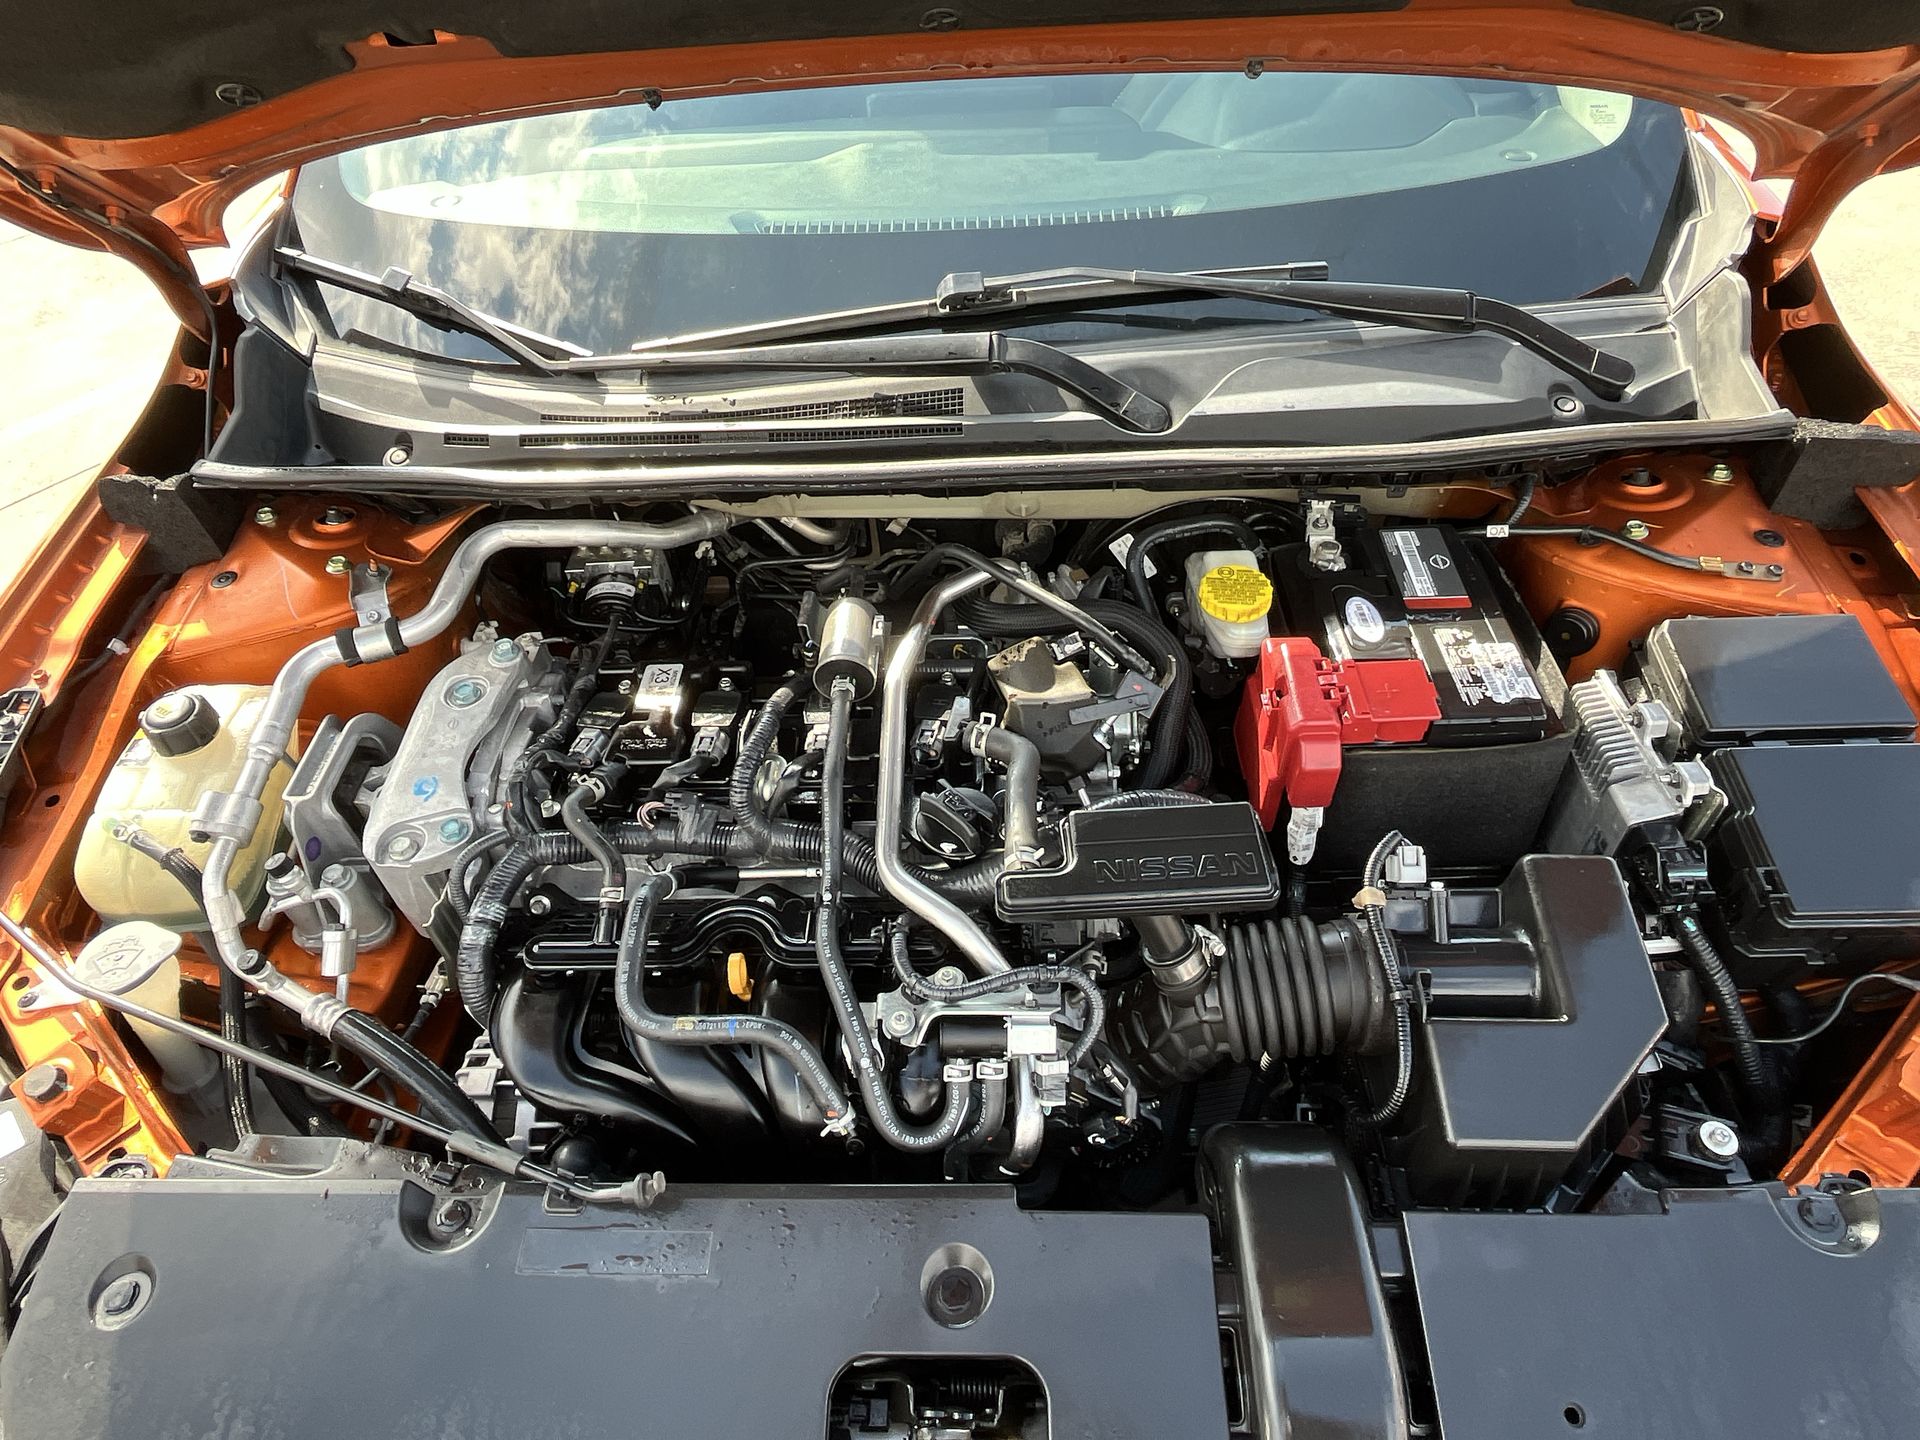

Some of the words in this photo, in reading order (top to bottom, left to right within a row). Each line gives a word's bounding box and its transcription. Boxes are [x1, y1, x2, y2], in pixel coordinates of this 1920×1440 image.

[654, 667, 673, 684] X3
[1093, 852, 1259, 883] NISSAN
[849, 1015, 876, 1078] TRD>ECO<704
